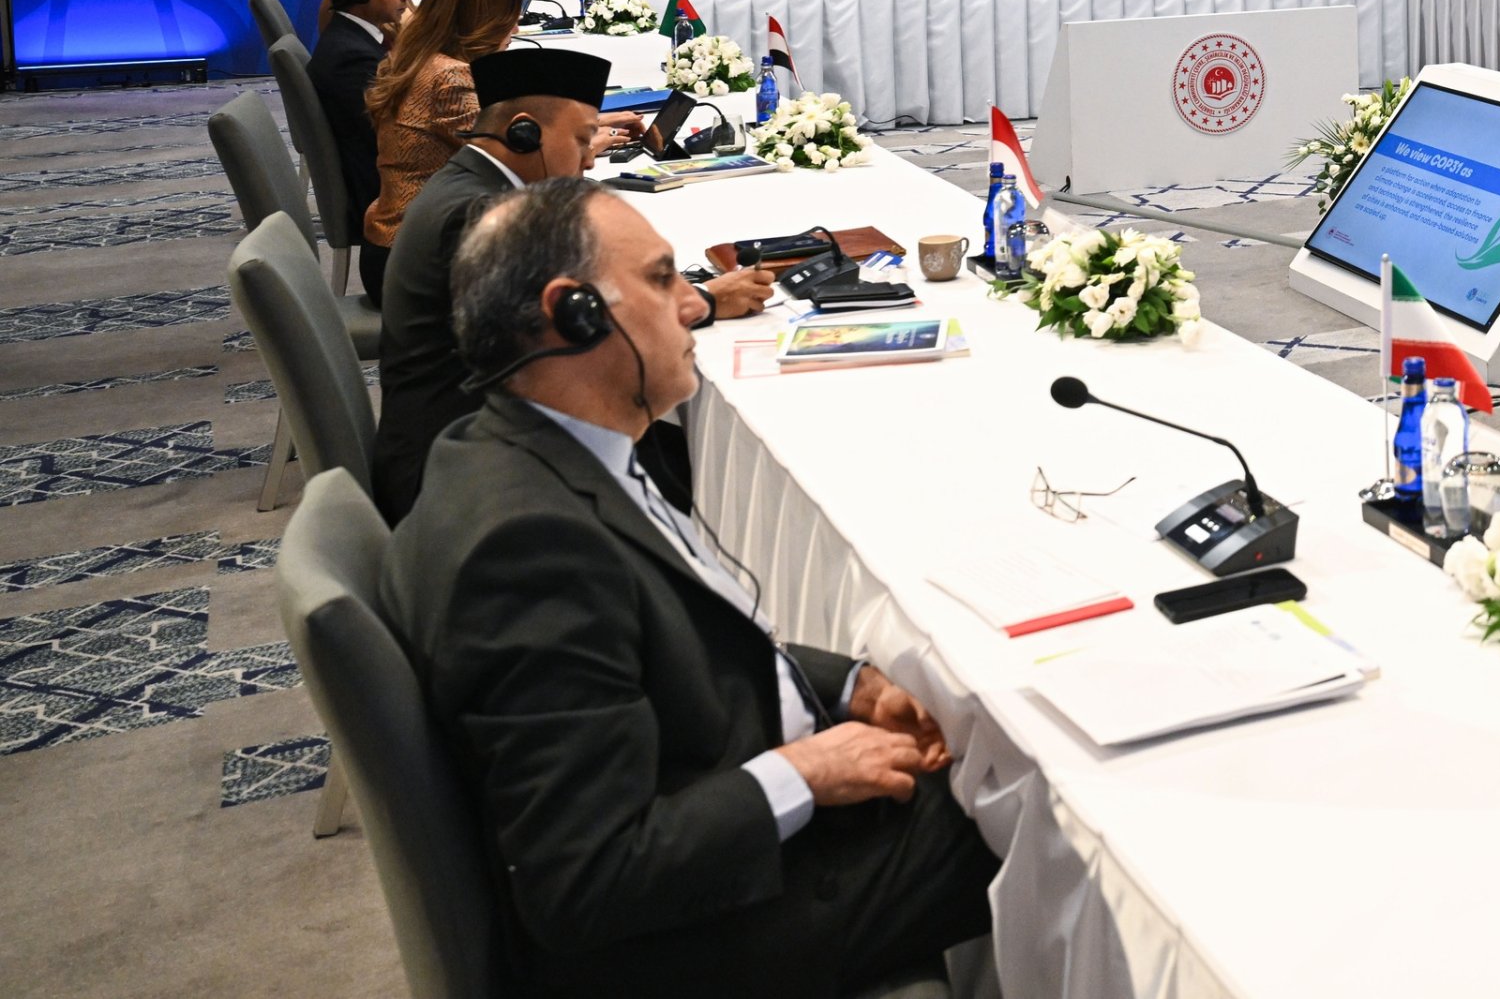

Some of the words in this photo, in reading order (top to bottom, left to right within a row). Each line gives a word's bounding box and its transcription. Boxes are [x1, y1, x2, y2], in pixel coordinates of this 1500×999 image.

[1394, 142, 1410, 156] We
[1408, 148, 1432, 163] view
[1430, 154, 1465, 174] COP31
[1460, 166, 1473, 177] as
